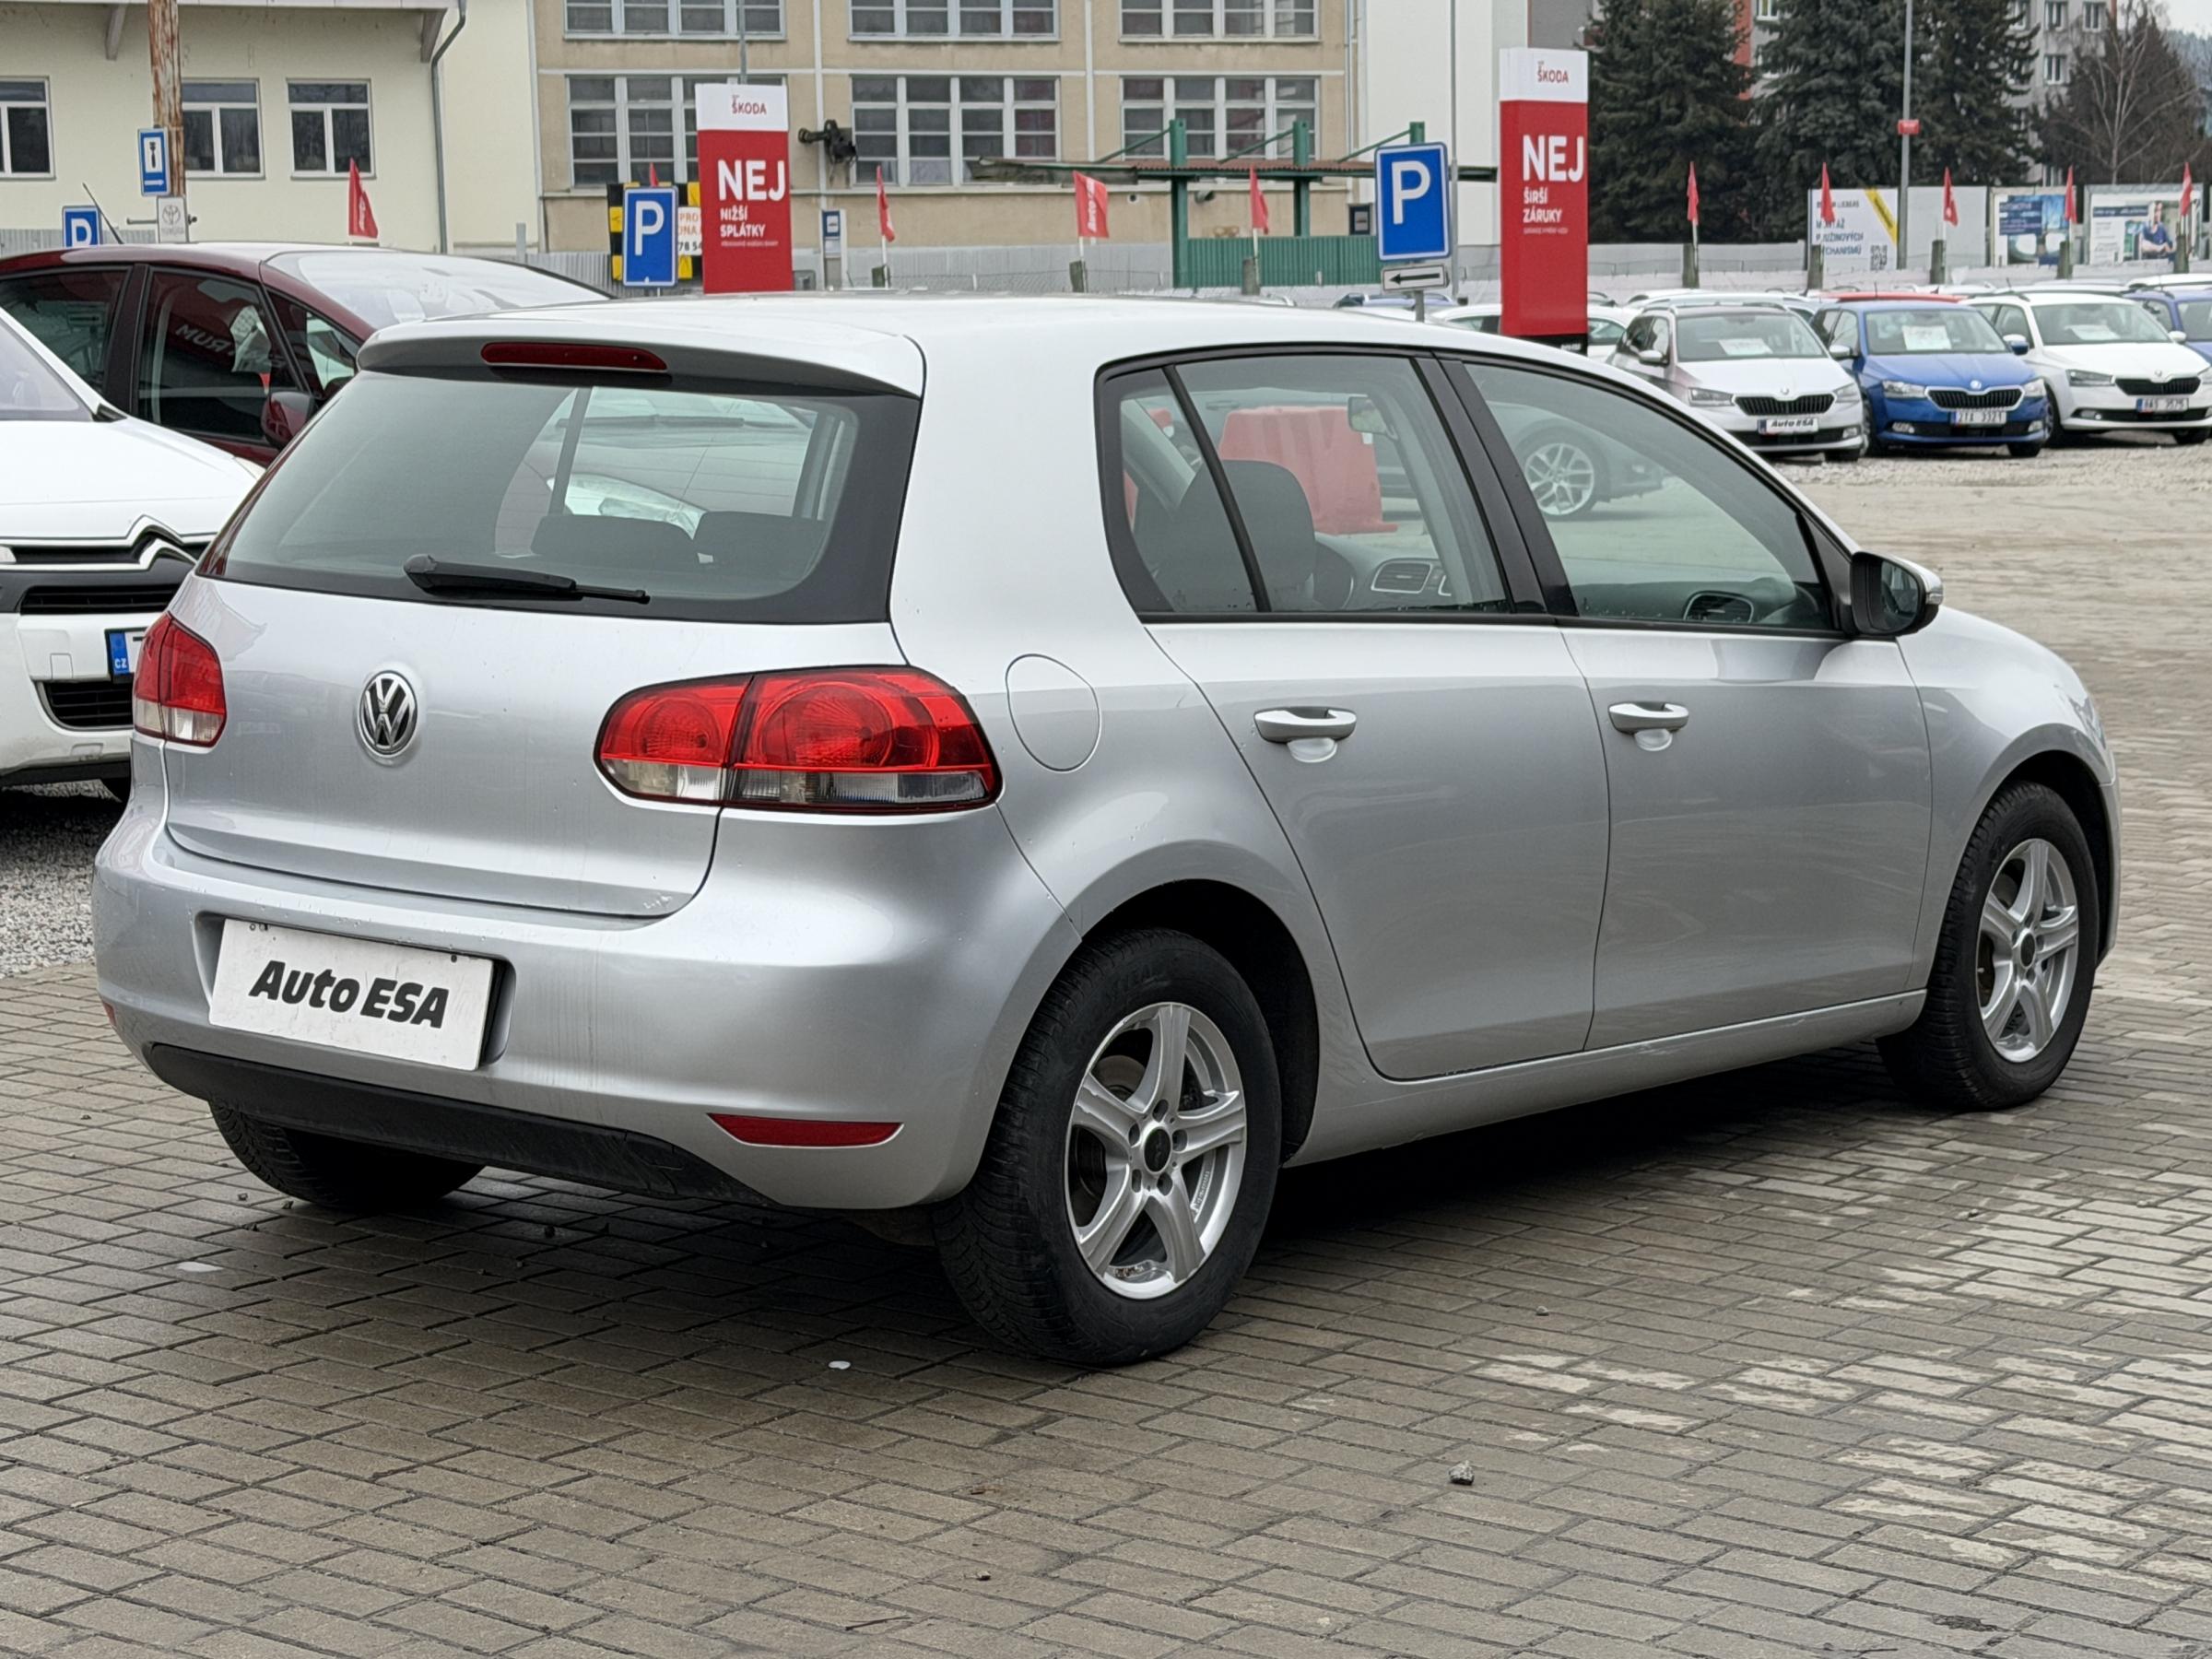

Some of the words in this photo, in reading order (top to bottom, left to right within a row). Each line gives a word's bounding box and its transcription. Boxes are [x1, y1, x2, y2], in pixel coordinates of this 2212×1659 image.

[1537, 64, 1569, 83] ŠKODA
[732, 97, 767, 115] ŠKODA
[1523, 135, 1584, 182] NEJ
[718, 159, 785, 201] NEJ
[1392, 160, 1431, 225] P
[1524, 186, 1547, 204] ŠIRŠÍ
[720, 205, 748, 221] NIŽŠÍ
[1523, 206, 1562, 223] ZÁRUKY
[71, 218, 92, 246] P
[635, 200, 665, 255] P
[720, 222, 766, 238] SPLÁTKY
[1771, 419, 1794, 429] Auto
[114, 657, 127, 669] CZ
[248, 959, 360, 1013] Auto
[360, 977, 450, 1030] ESA
